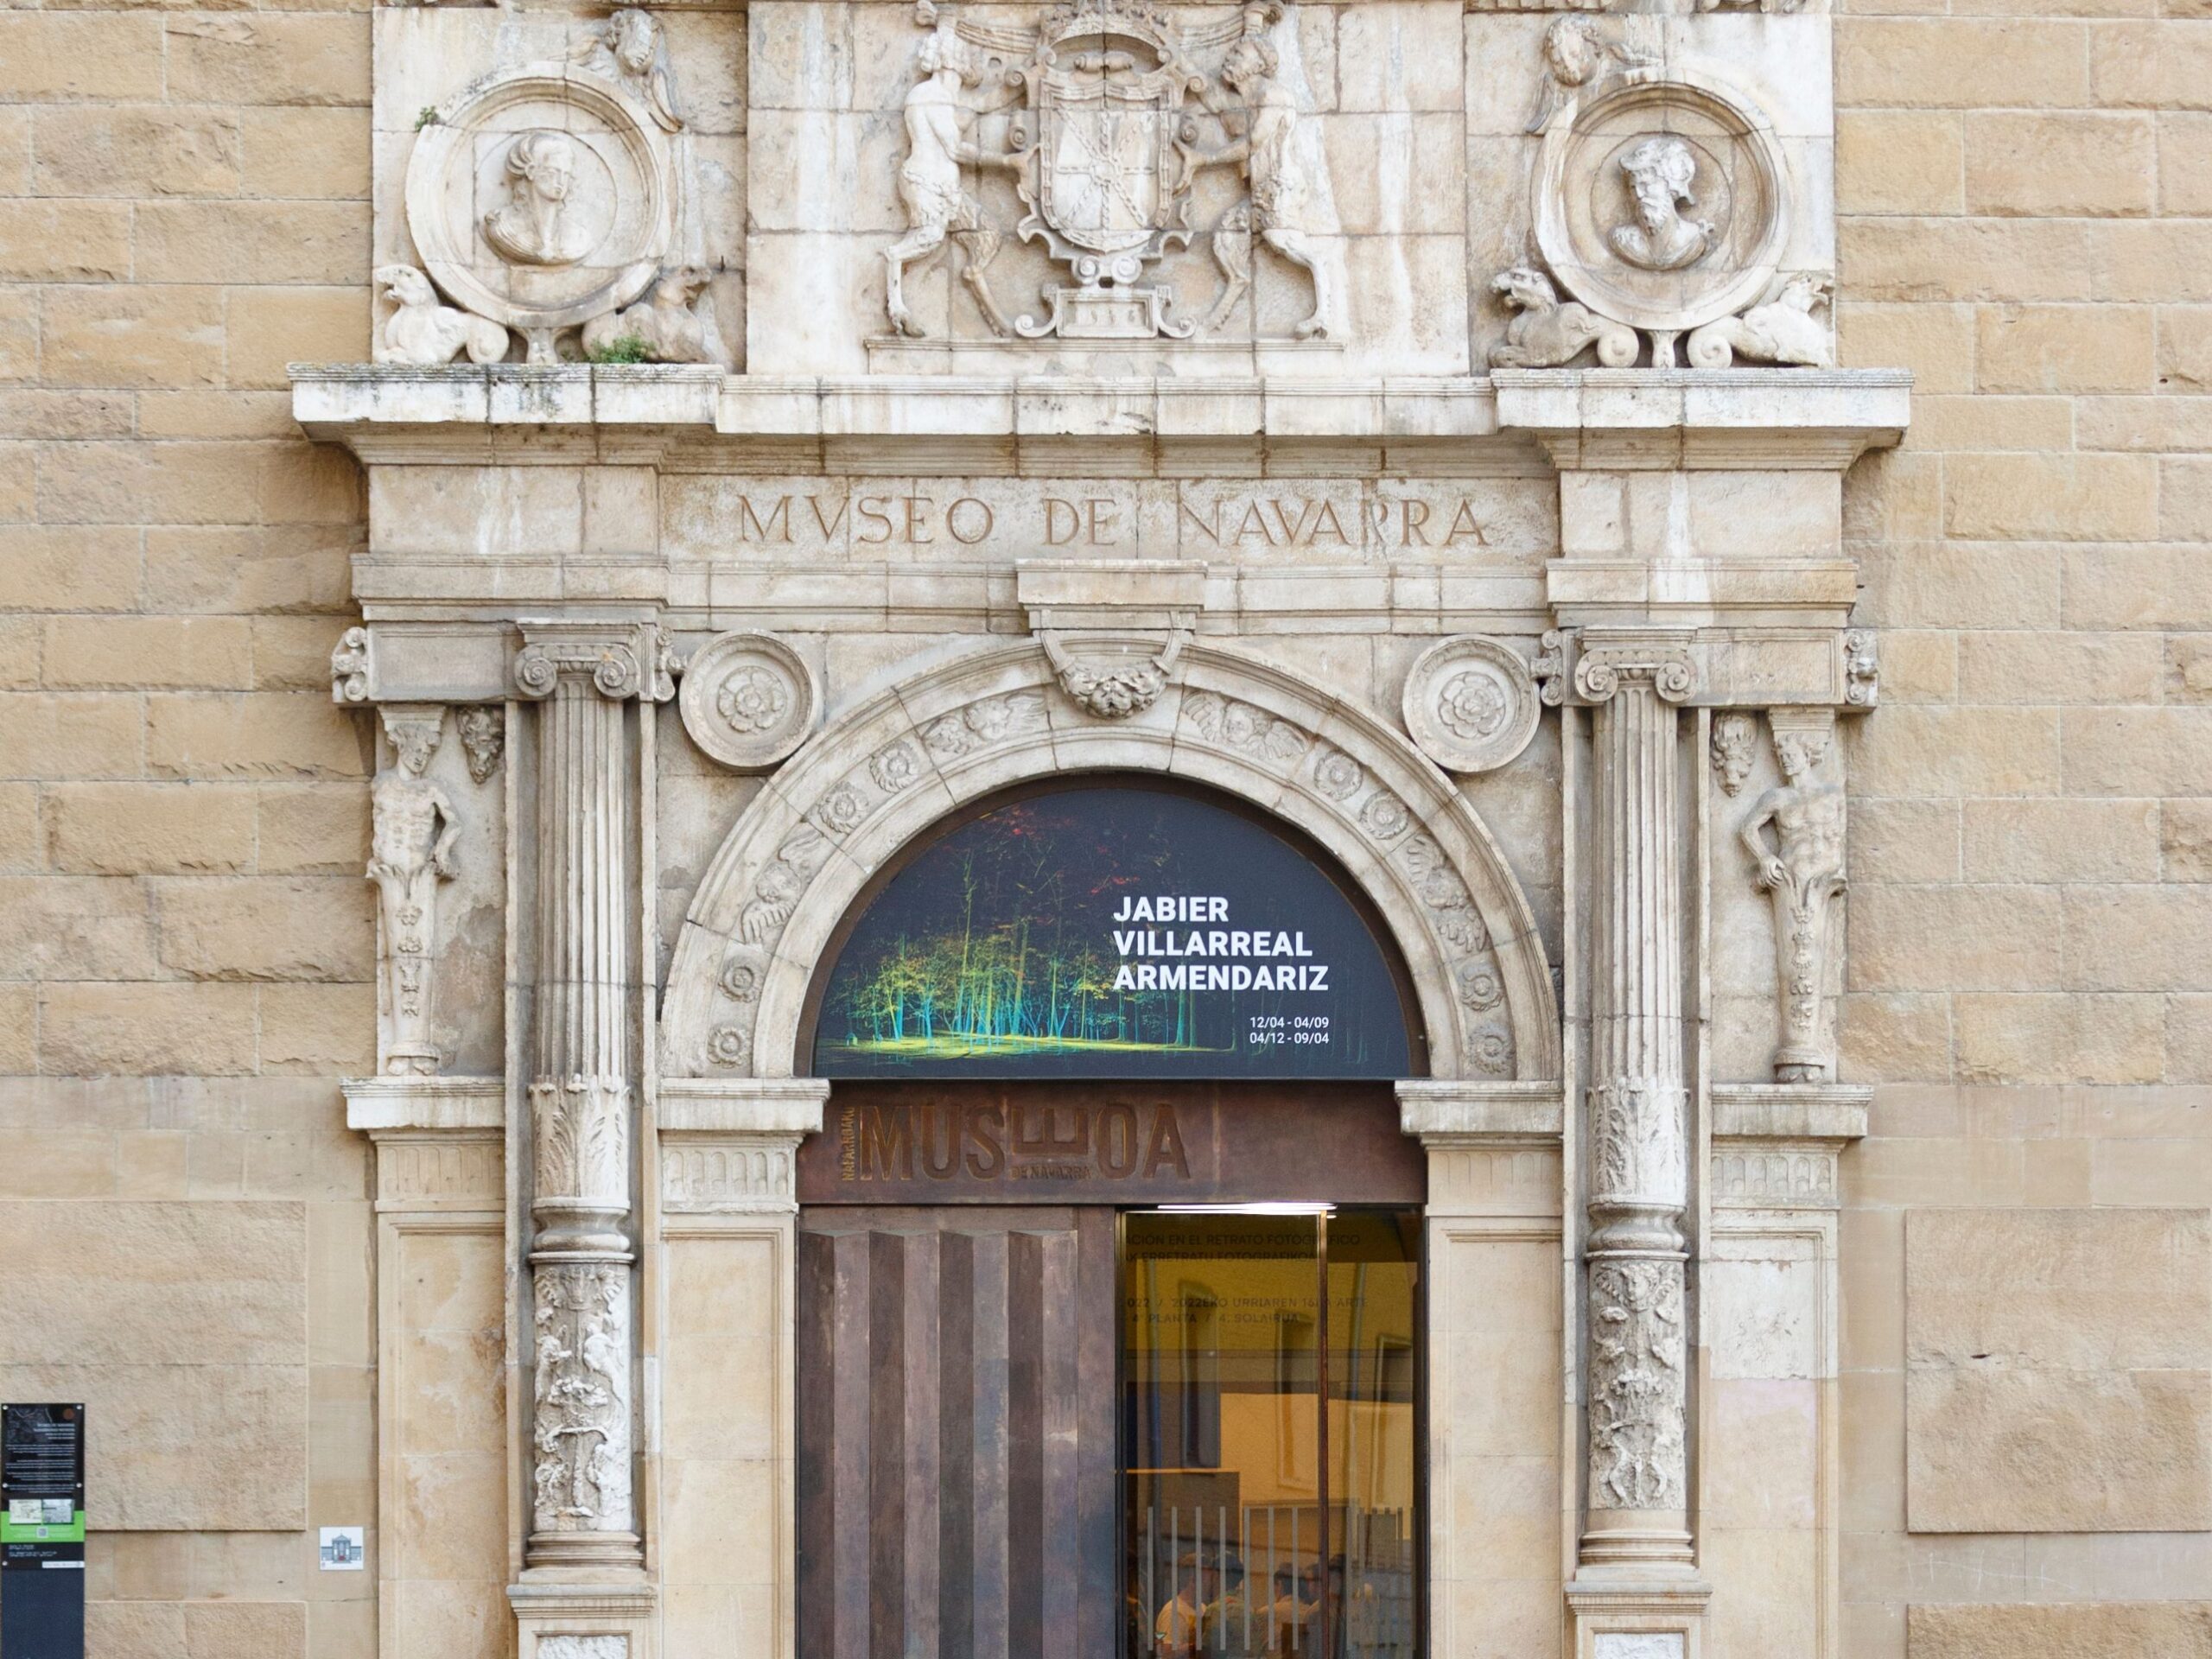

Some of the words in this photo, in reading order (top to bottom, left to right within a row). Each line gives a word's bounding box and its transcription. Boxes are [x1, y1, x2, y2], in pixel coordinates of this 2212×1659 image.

[737, 494, 995, 545] MVSEO
[1042, 498, 1117, 546] DE
[1178, 498, 1491, 547] NAVARRA
[1113, 895, 1230, 922] JABIER
[1112, 930, 1313, 957] VILLARREAL
[1112, 964, 1329, 991] ARMENDARIZ
[1249, 1016, 1285, 1029] 12/04
[1294, 1016, 1329, 1029] 04/09
[1249, 1033, 1285, 1045] 04/12
[1294, 1033, 1329, 1045] 09/04
[1168, 1234, 1185, 1245] EN
[1188, 1234, 1202, 1245] EL
[1206, 1234, 1263, 1245] RETRATO
